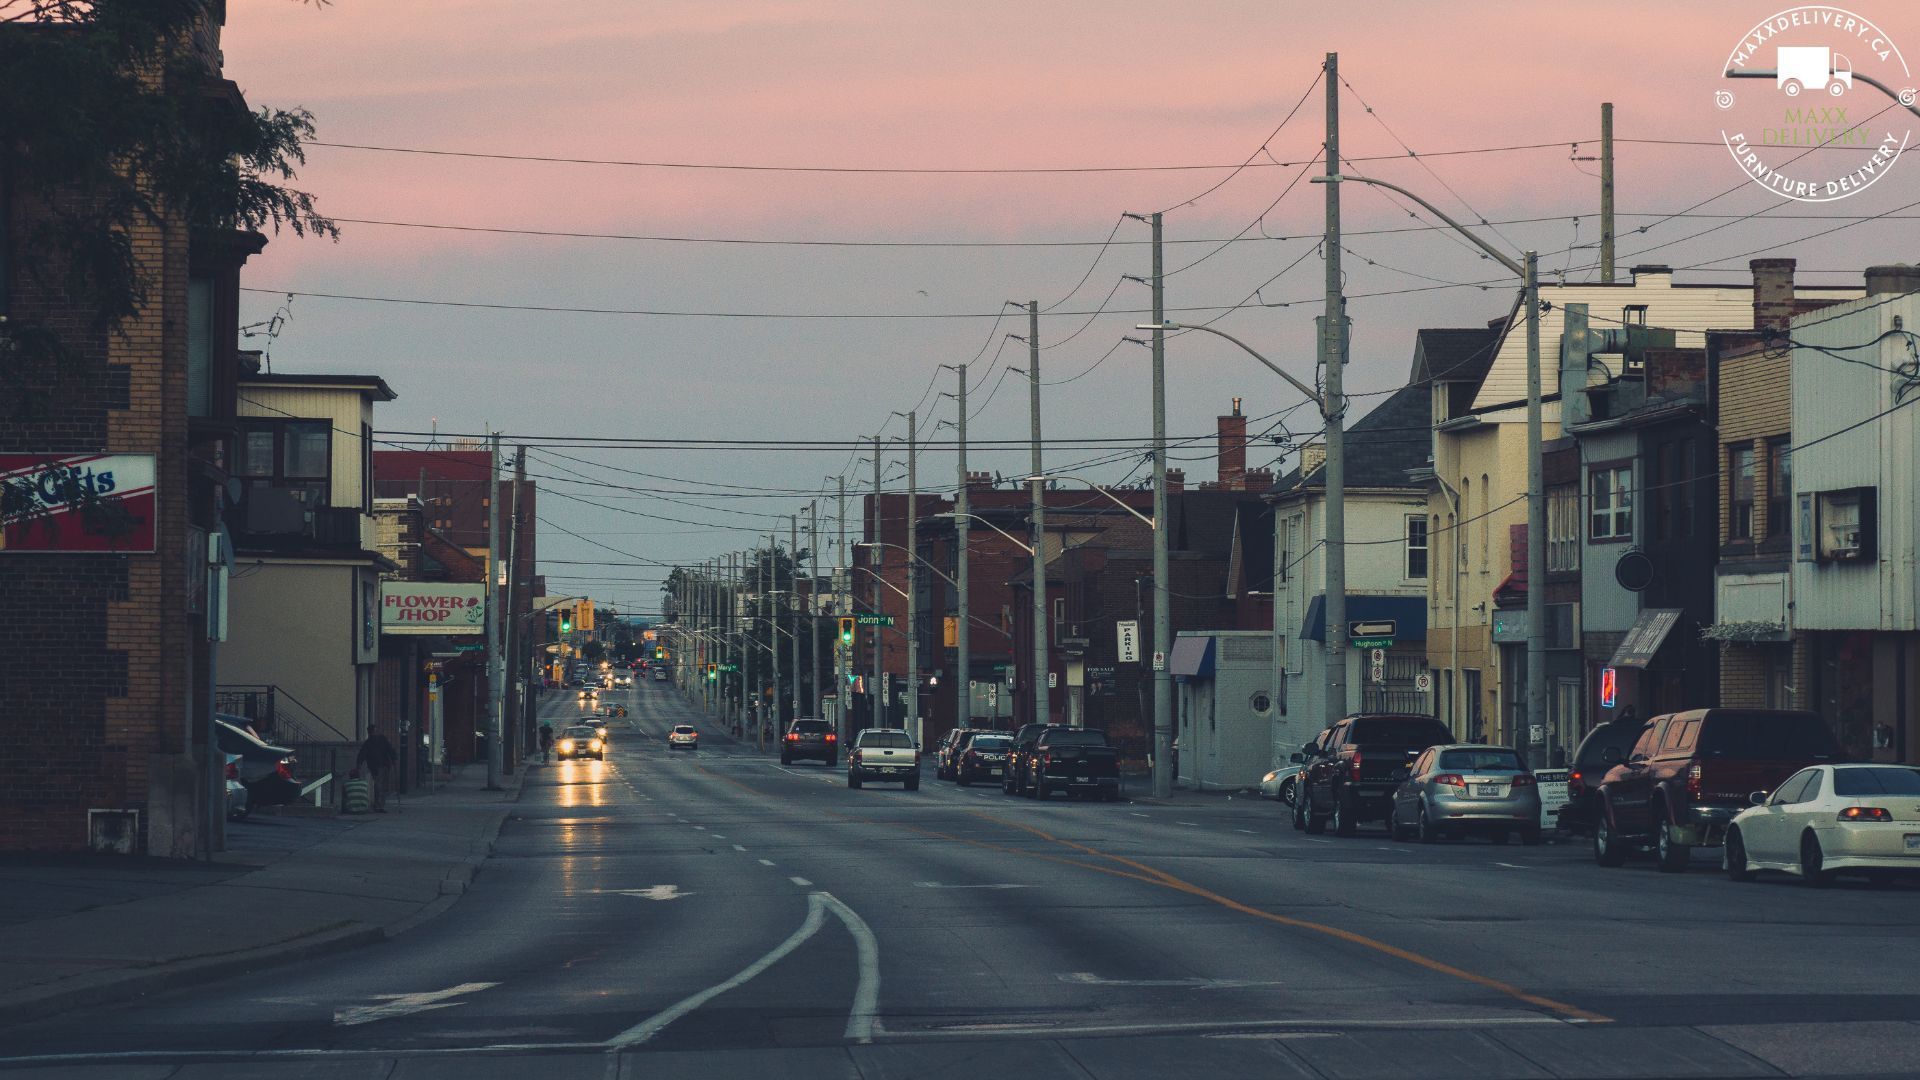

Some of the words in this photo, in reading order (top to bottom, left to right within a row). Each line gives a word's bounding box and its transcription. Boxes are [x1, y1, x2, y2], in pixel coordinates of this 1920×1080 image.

[385, 595, 464, 609] FLOWER
[395, 609, 451, 621] SHOP
[858, 615, 879, 624] John
[887, 617, 894, 625] N
[1124, 628, 1133, 660] PARKING
